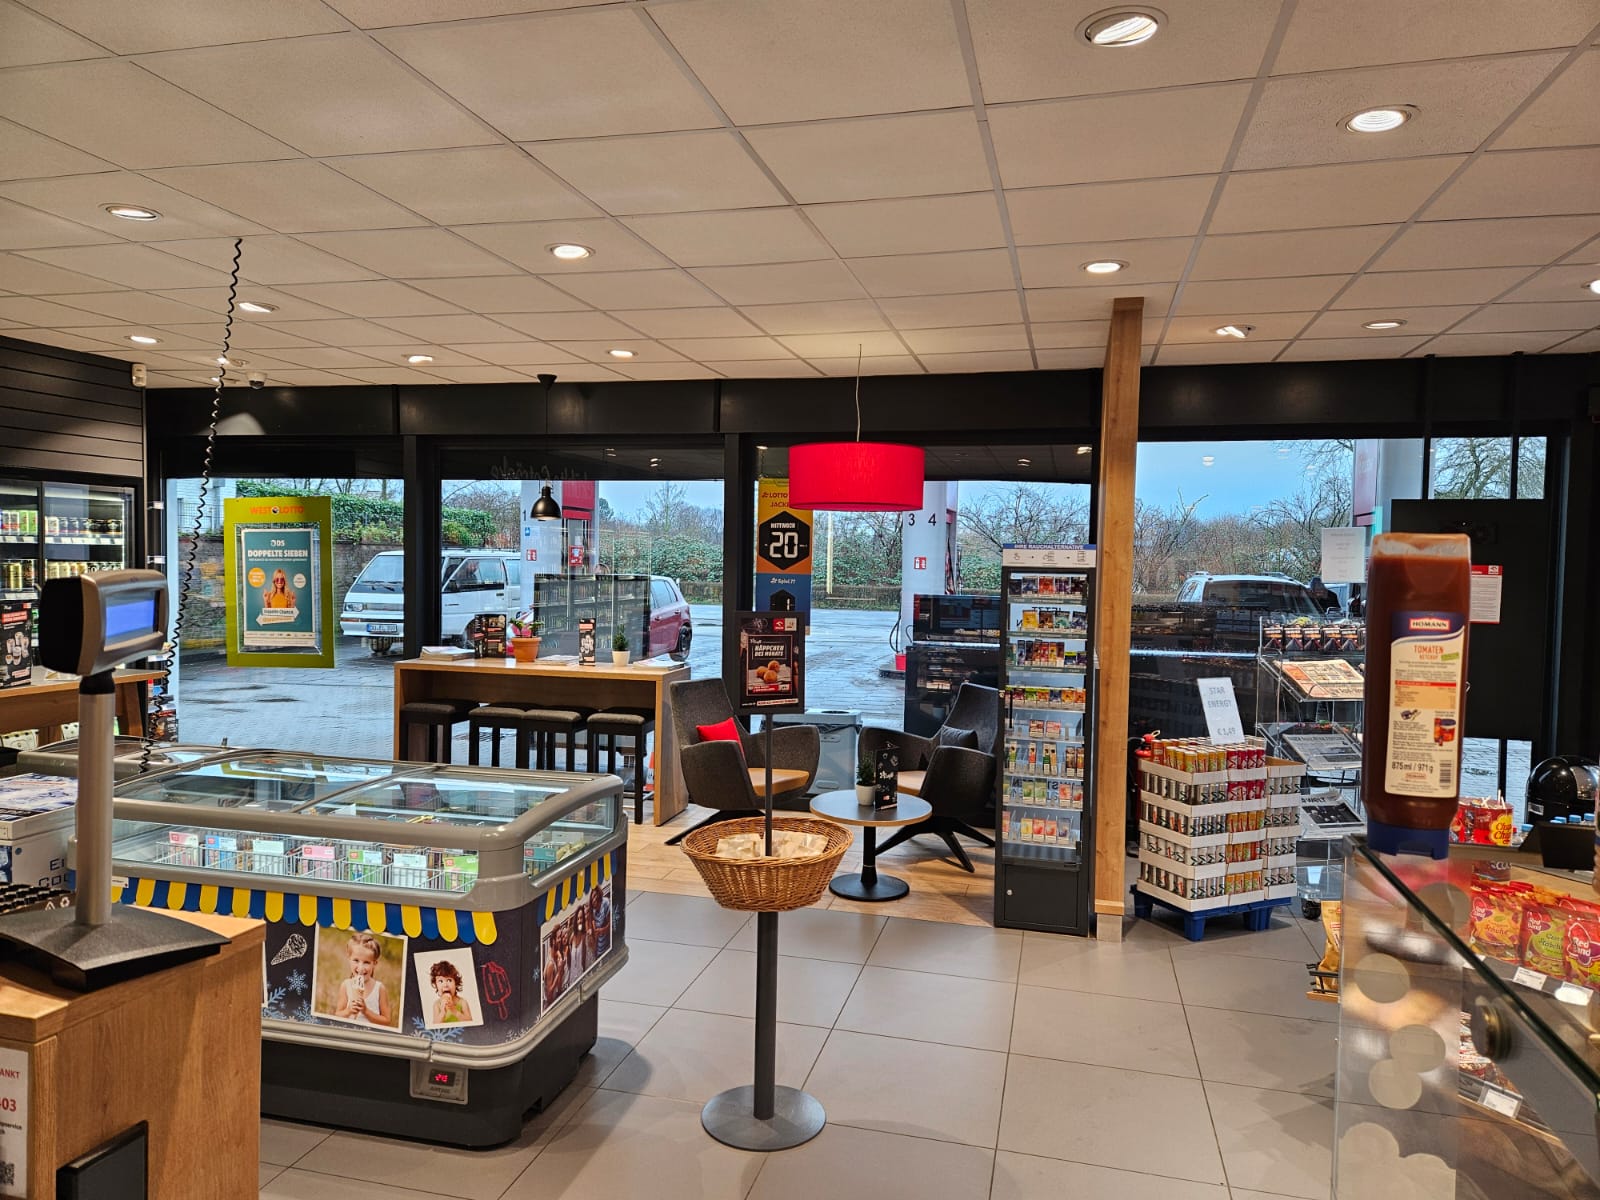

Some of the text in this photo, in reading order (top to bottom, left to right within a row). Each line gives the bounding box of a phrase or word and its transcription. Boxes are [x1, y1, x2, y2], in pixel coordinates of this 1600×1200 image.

[908, 513, 916, 527] 3
[928, 513, 937, 527] 4
[769, 531, 799, 559] 20
[247, 549, 308, 558] DOPPELTE SIEBEN
[1413, 645, 1444, 654] TOMATEN
[1573, 937, 1590, 949] Red
